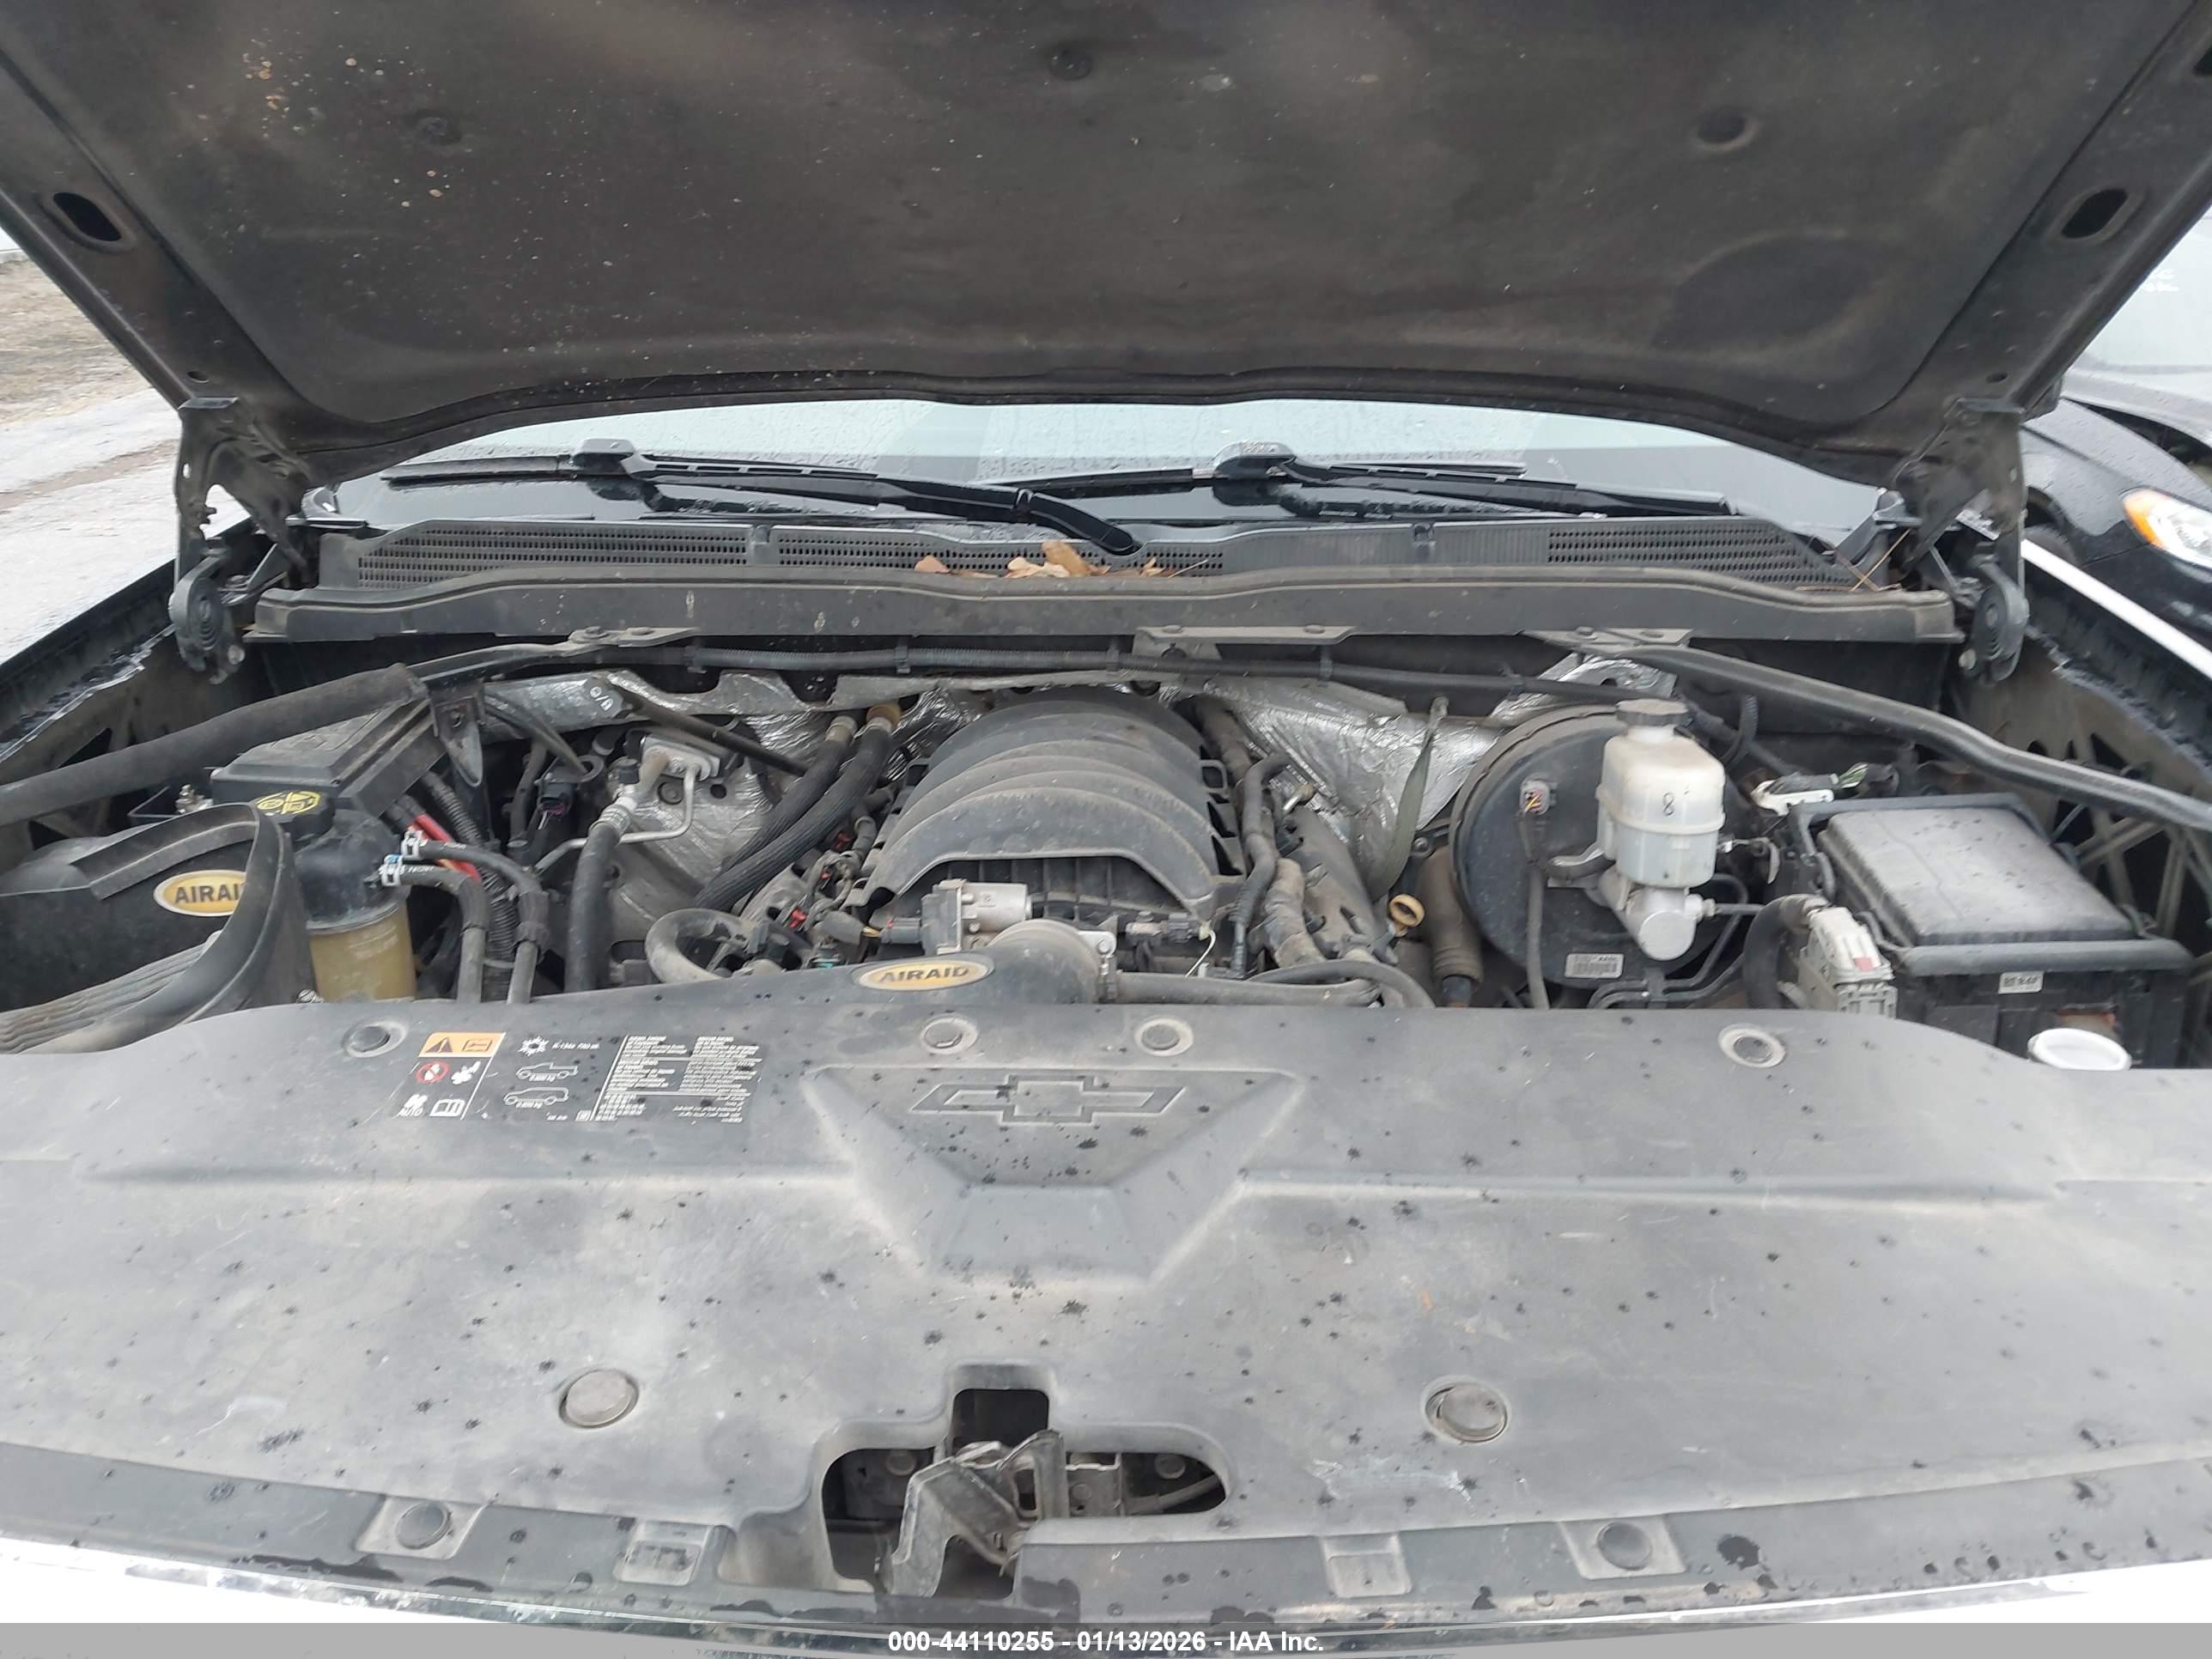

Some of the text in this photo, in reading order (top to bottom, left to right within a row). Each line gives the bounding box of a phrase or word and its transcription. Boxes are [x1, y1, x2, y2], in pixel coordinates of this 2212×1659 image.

[1662, 792, 1674, 817] 8
[175, 883, 242, 904] AIRAI
[879, 967, 969, 983] AIRAID
